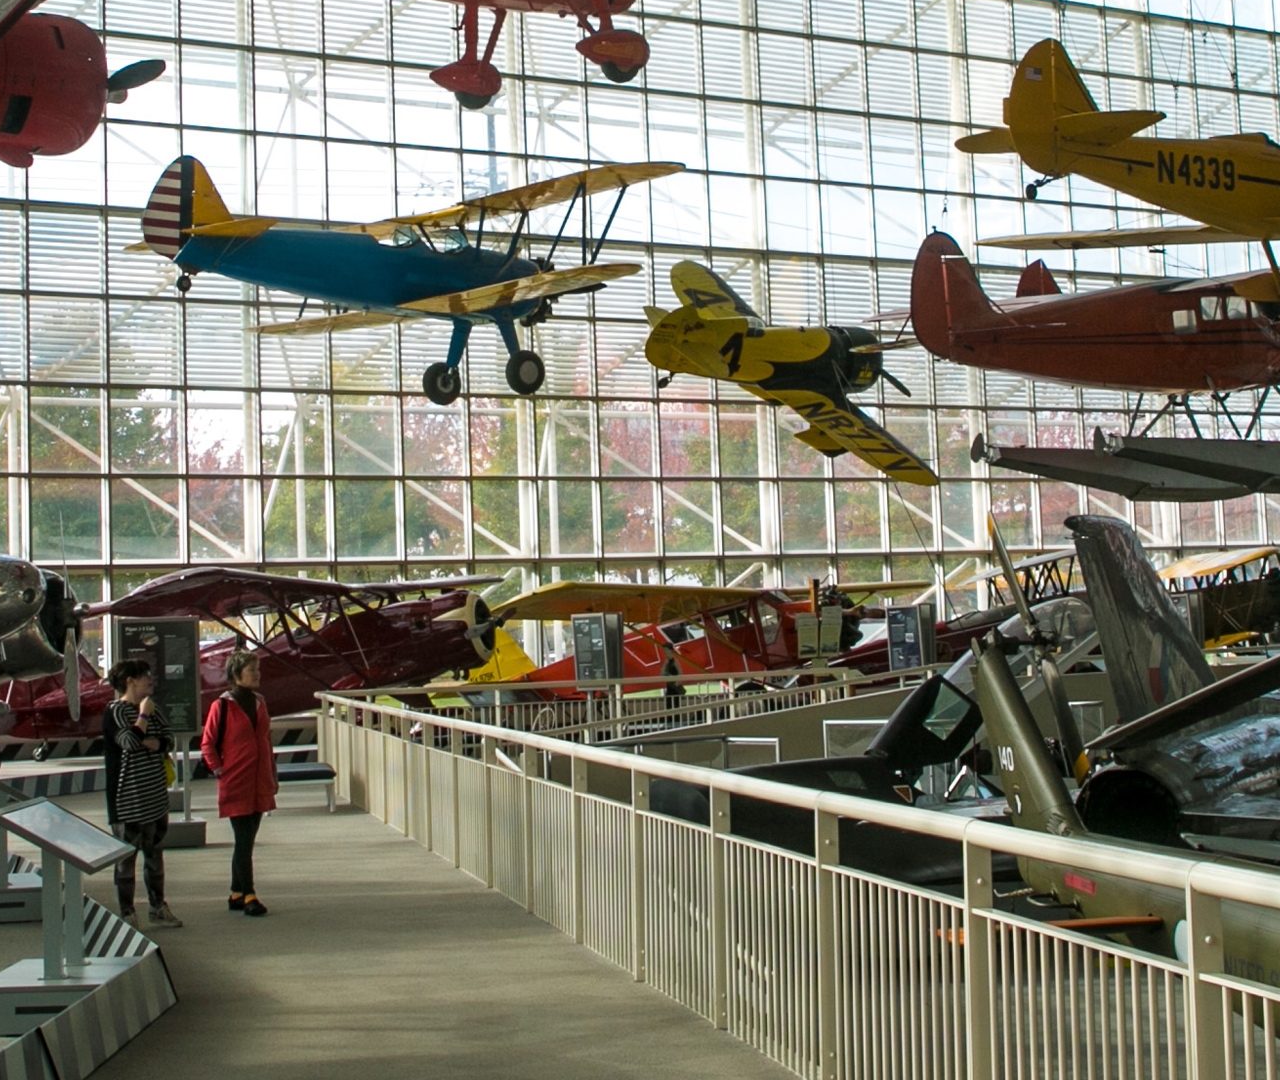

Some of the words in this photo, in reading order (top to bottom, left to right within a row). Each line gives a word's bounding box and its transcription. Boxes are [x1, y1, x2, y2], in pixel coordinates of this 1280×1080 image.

[1157, 150, 1235, 192] N4339
[793, 402, 924, 471] NR77V
[998, 745, 1014, 772] 140
